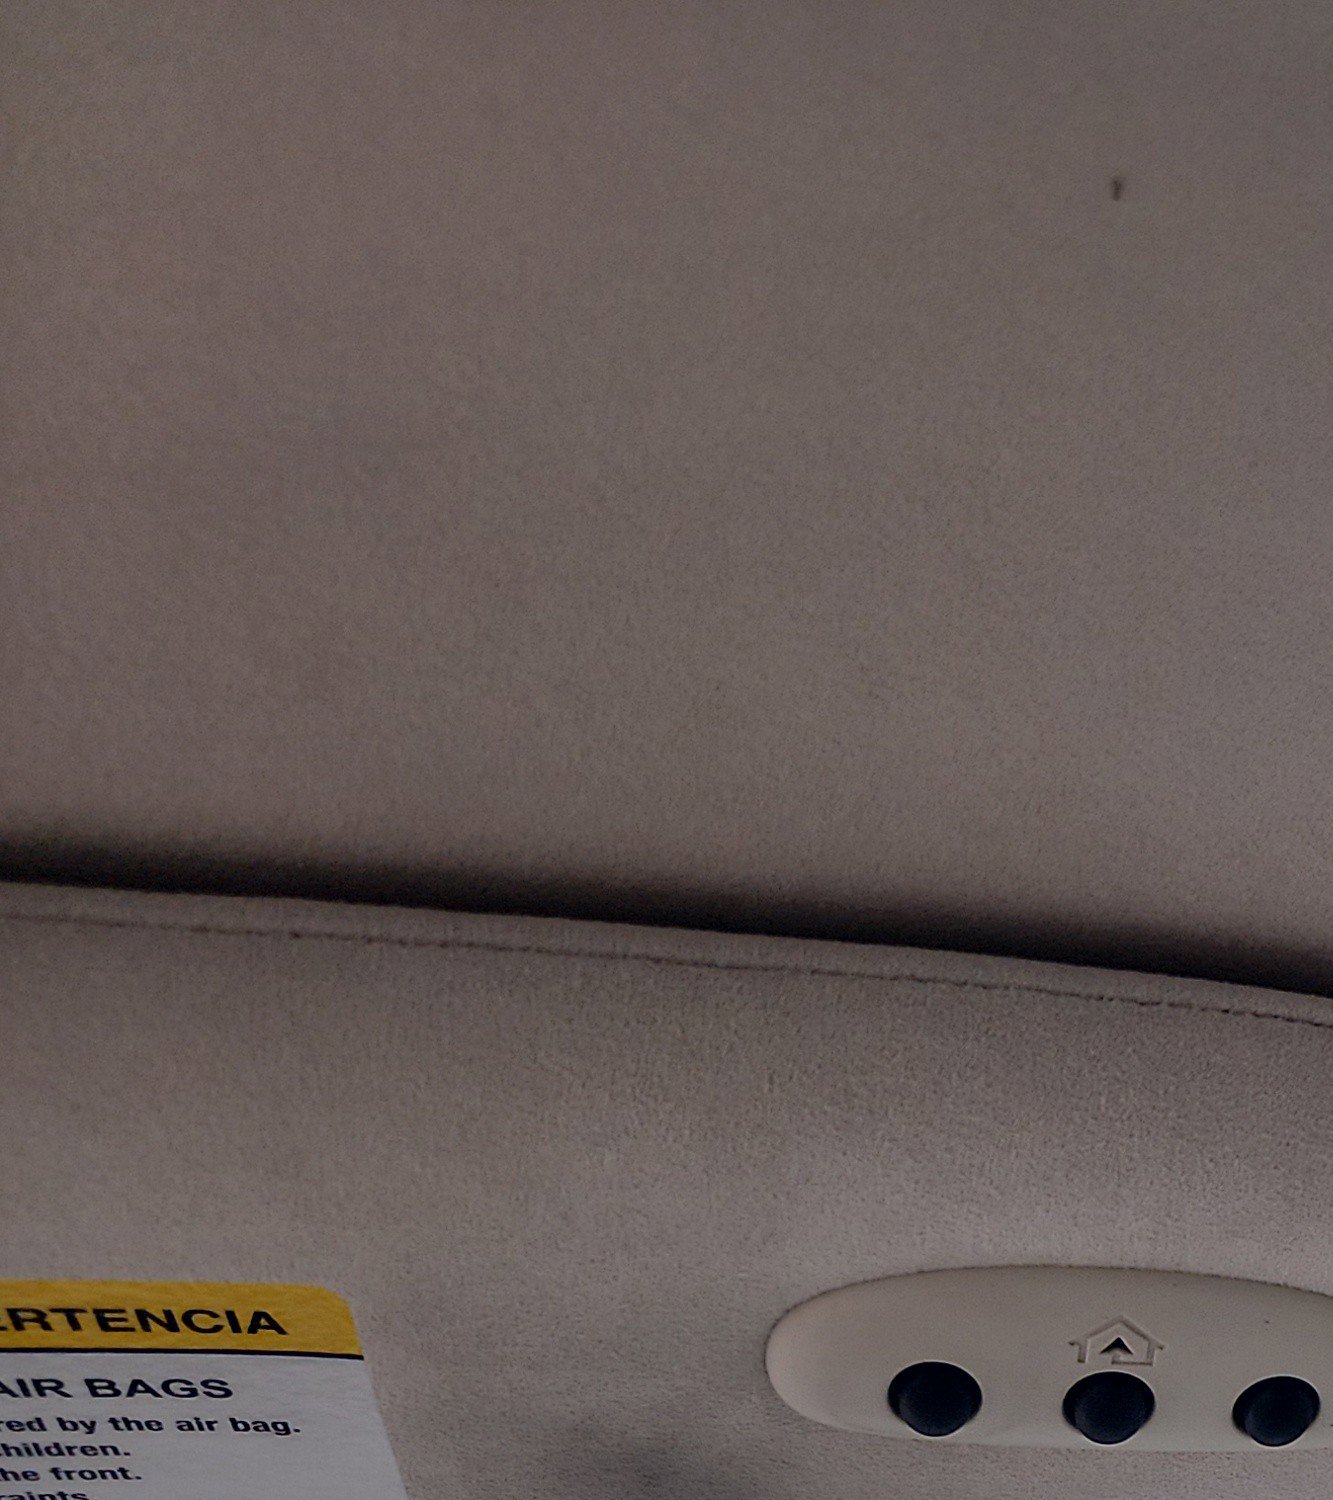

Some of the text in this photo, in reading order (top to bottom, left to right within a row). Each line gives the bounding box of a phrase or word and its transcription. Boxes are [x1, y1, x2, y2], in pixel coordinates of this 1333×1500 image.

[0, 1308, 289, 1335] RTENCIA
[84, 1378, 234, 1398] BAGS
[56, 1417, 97, 1434] by
[108, 1417, 164, 1432] the
[175, 1417, 218, 1432] air
[229, 1417, 301, 1436] bag.
[0, 1442, 131, 1457] hildren.
[0, 1467, 142, 1481] he front.
